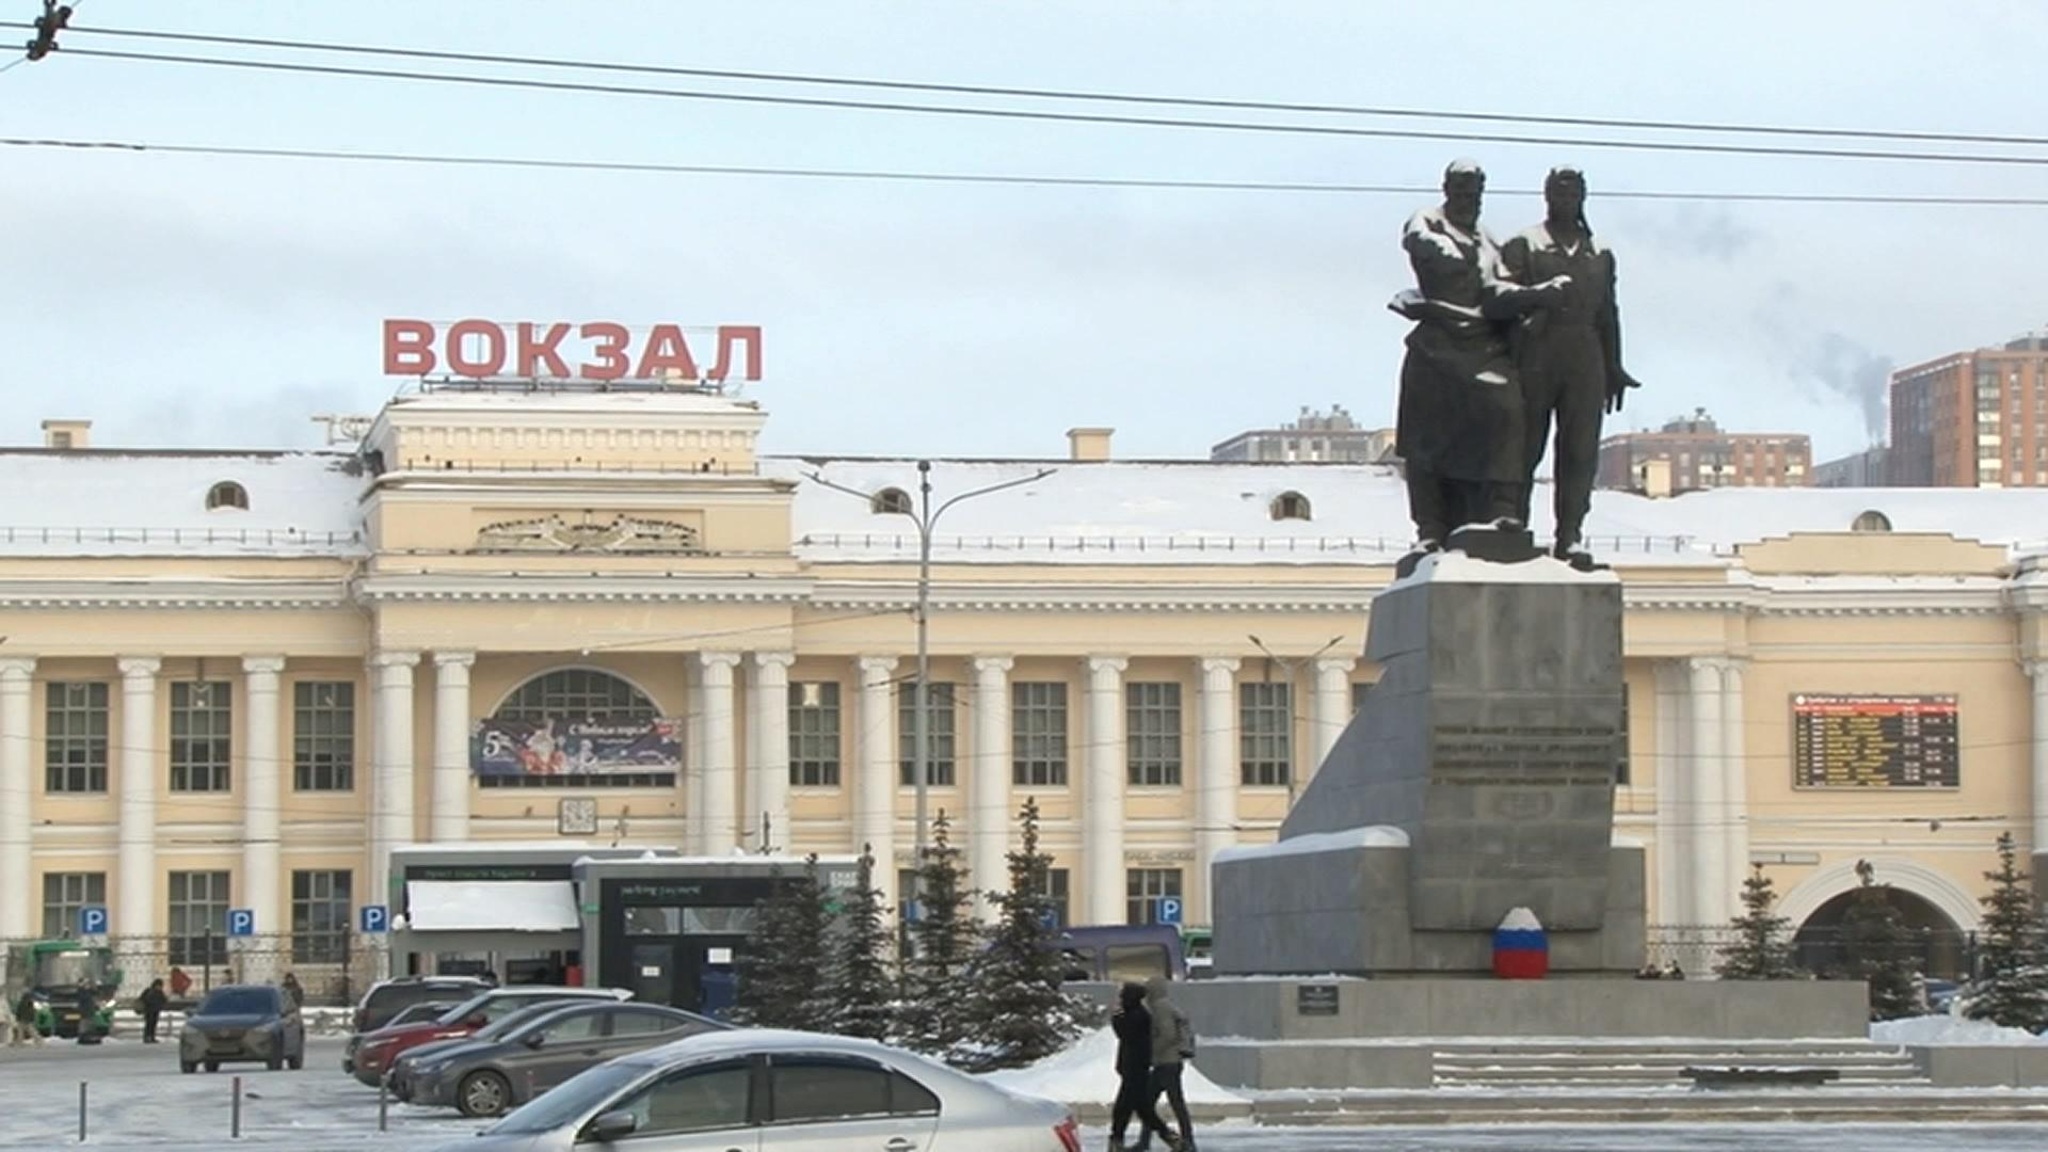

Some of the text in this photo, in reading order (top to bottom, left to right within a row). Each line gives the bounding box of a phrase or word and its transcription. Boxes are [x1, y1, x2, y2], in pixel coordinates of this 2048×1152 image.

[383, 318, 763, 382] ВОКЗАЛ
[87, 910, 103, 931] P
[366, 908, 383, 929] P
[1163, 900, 1179, 920] P
[233, 913, 250, 933] P
